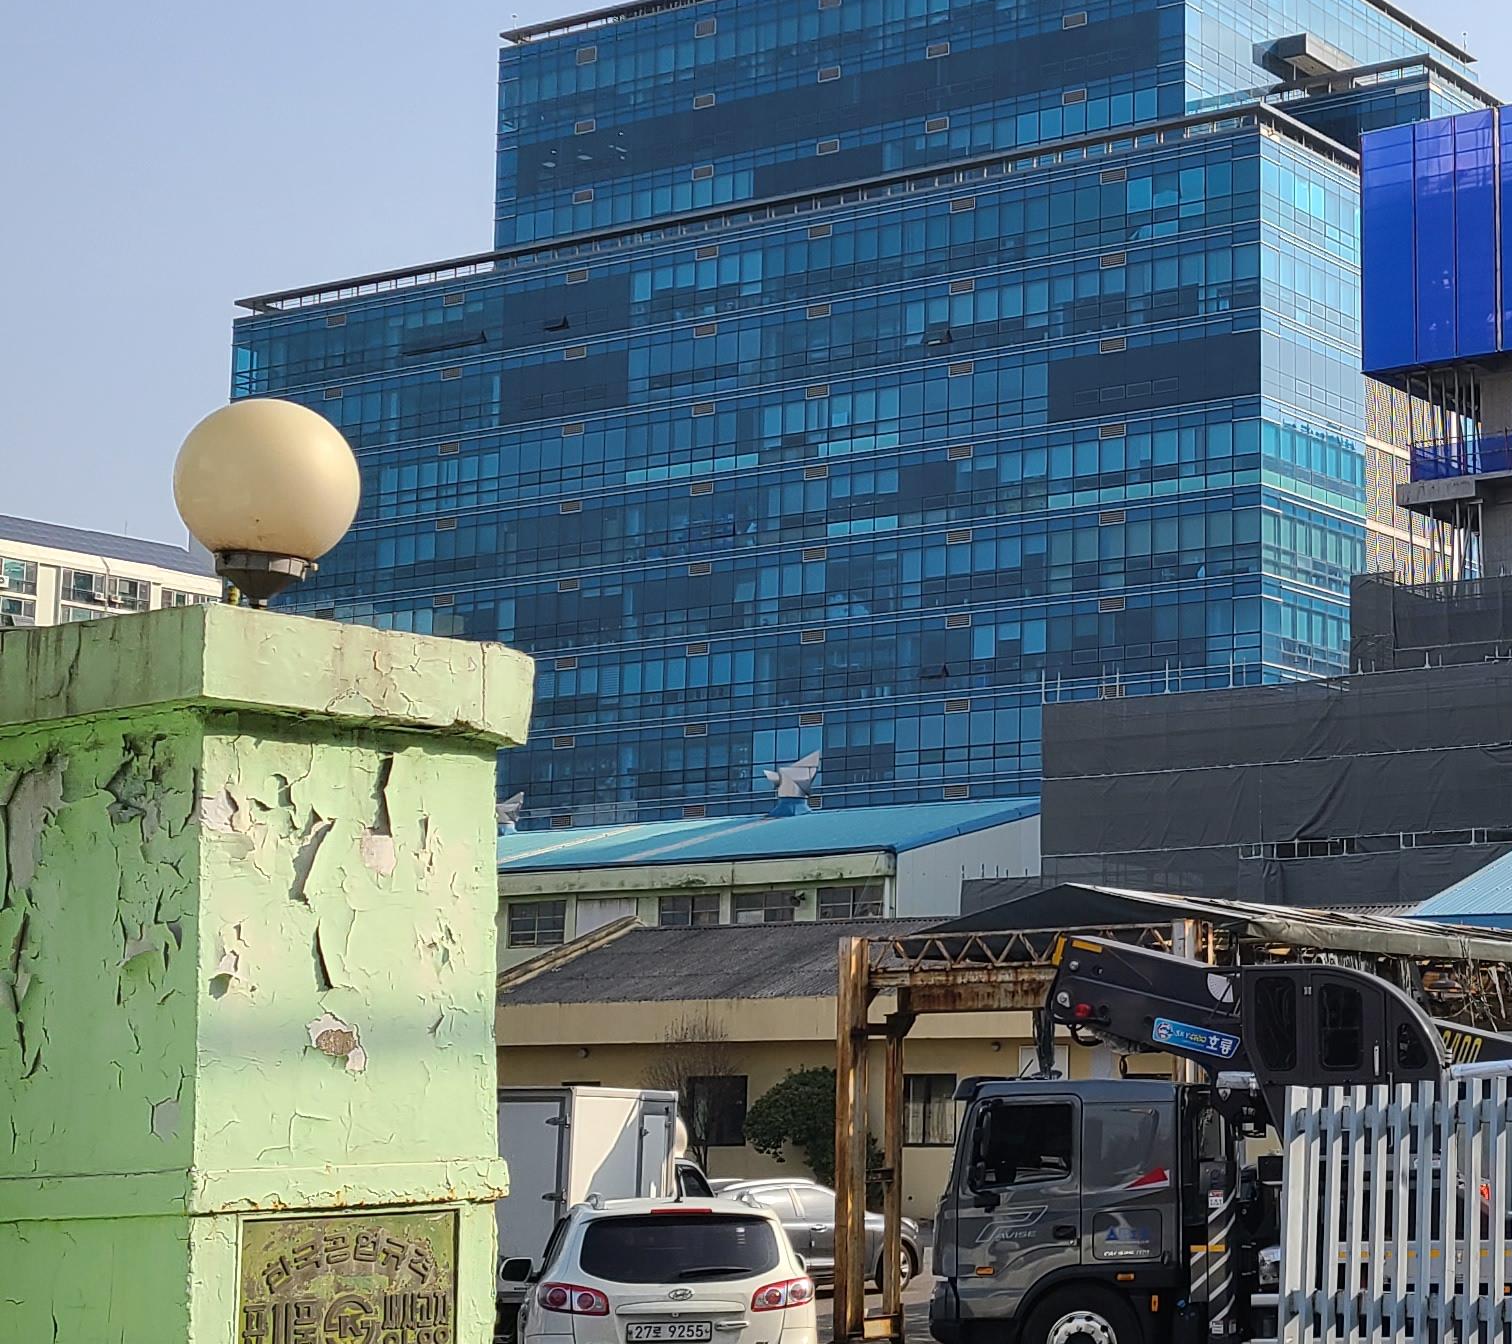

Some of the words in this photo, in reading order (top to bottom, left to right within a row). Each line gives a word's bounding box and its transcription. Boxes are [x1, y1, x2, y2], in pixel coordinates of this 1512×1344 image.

[1206, 1034, 1234, 1055] 호룡
[634, 1324, 662, 1340] 27로
[668, 1323, 704, 1339] 9255
